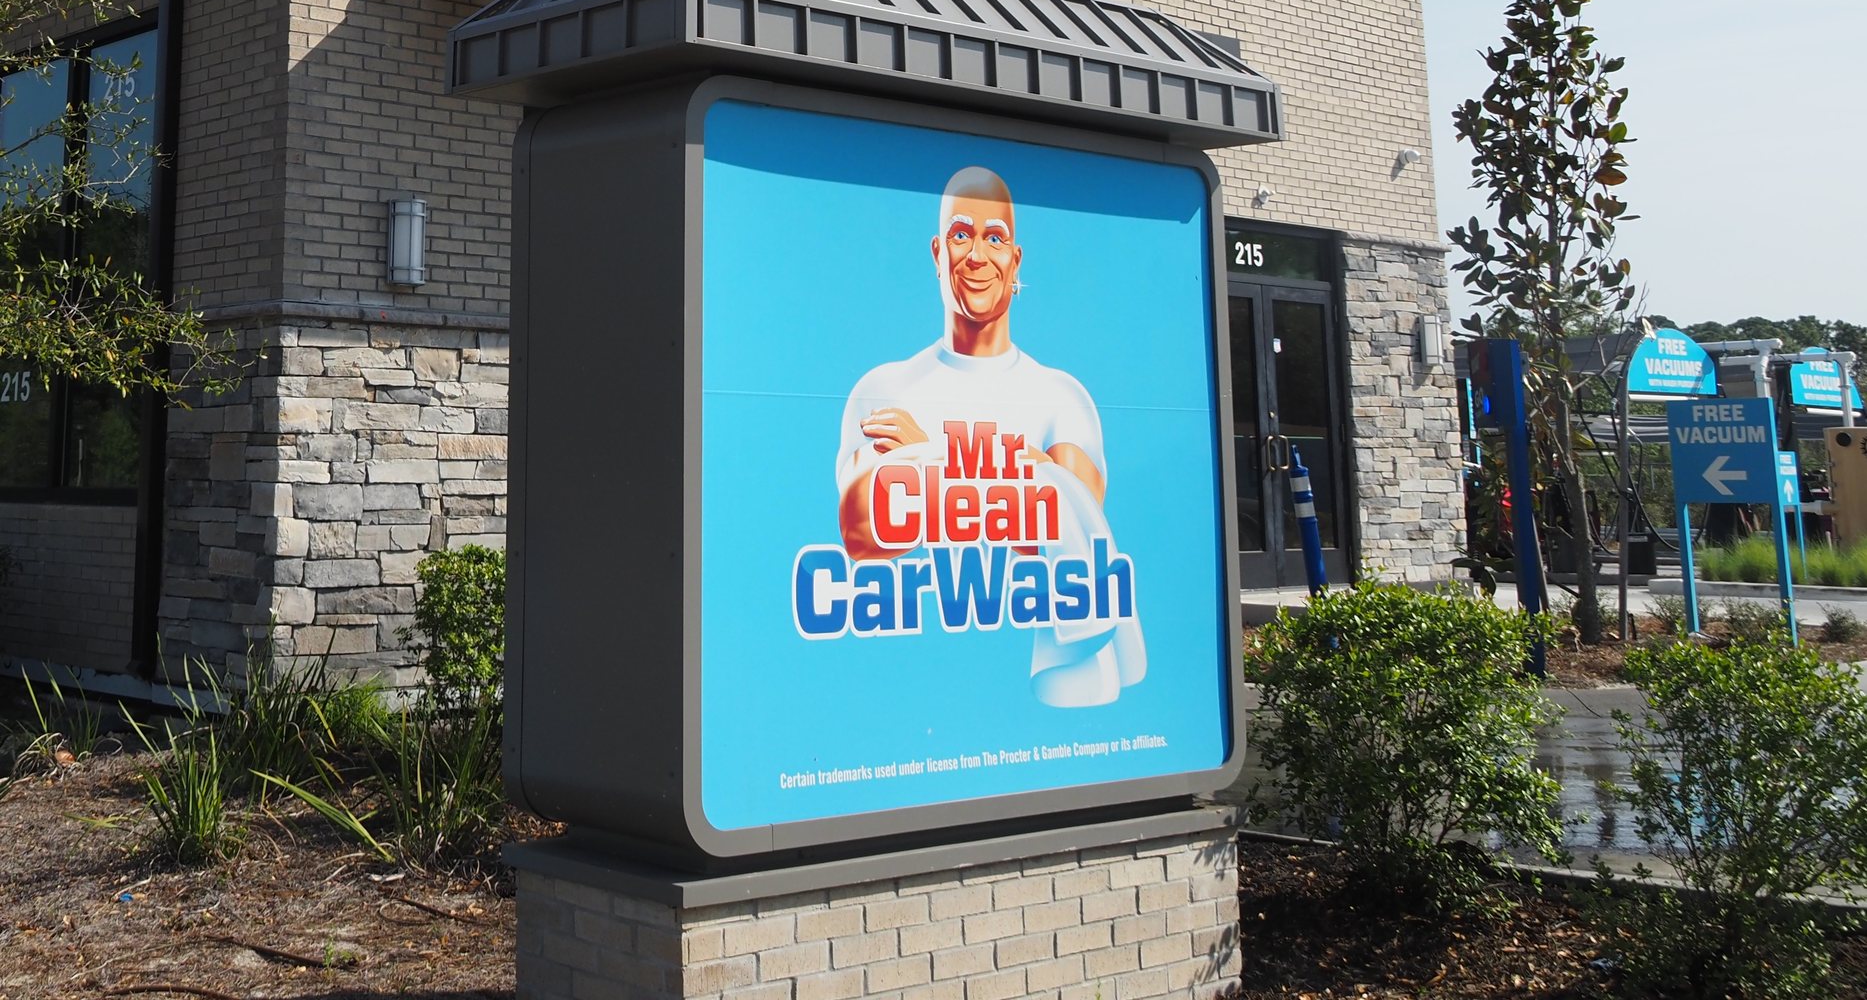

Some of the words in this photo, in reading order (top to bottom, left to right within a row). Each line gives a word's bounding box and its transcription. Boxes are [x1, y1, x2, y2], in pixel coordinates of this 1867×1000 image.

[1235, 241, 1264, 267] 215
[1657, 337, 1688, 356] FREE
[1644, 357, 1703, 377] VACUUMS
[1809, 360, 1835, 373] FREE
[1, 371, 31, 402] 215
[1692, 404, 1745, 422] FREE
[1676, 426, 1766, 444] VACUUM
[943, 420, 1034, 480] Mr.
[873, 464, 1060, 544] Clean
[795, 536, 1134, 635] CarWash
[780, 769, 816, 789] Certain
[818, 765, 873, 785] trademarks
[874, 762, 897, 779] used
[898, 758, 925, 776] under
[926, 754, 959, 773] license
[960, 750, 981, 769] from
[982, 751, 998, 767] The
[999, 747, 1032, 766] Procter
[1033, 746, 1041, 761] &
[1041, 743, 1072, 760] Gamble
[1073, 740, 1110, 757] Company
[1110, 740, 1120, 753] or
[1120, 737, 1132, 751] its
[1132, 734, 1169, 750] affiliates.
